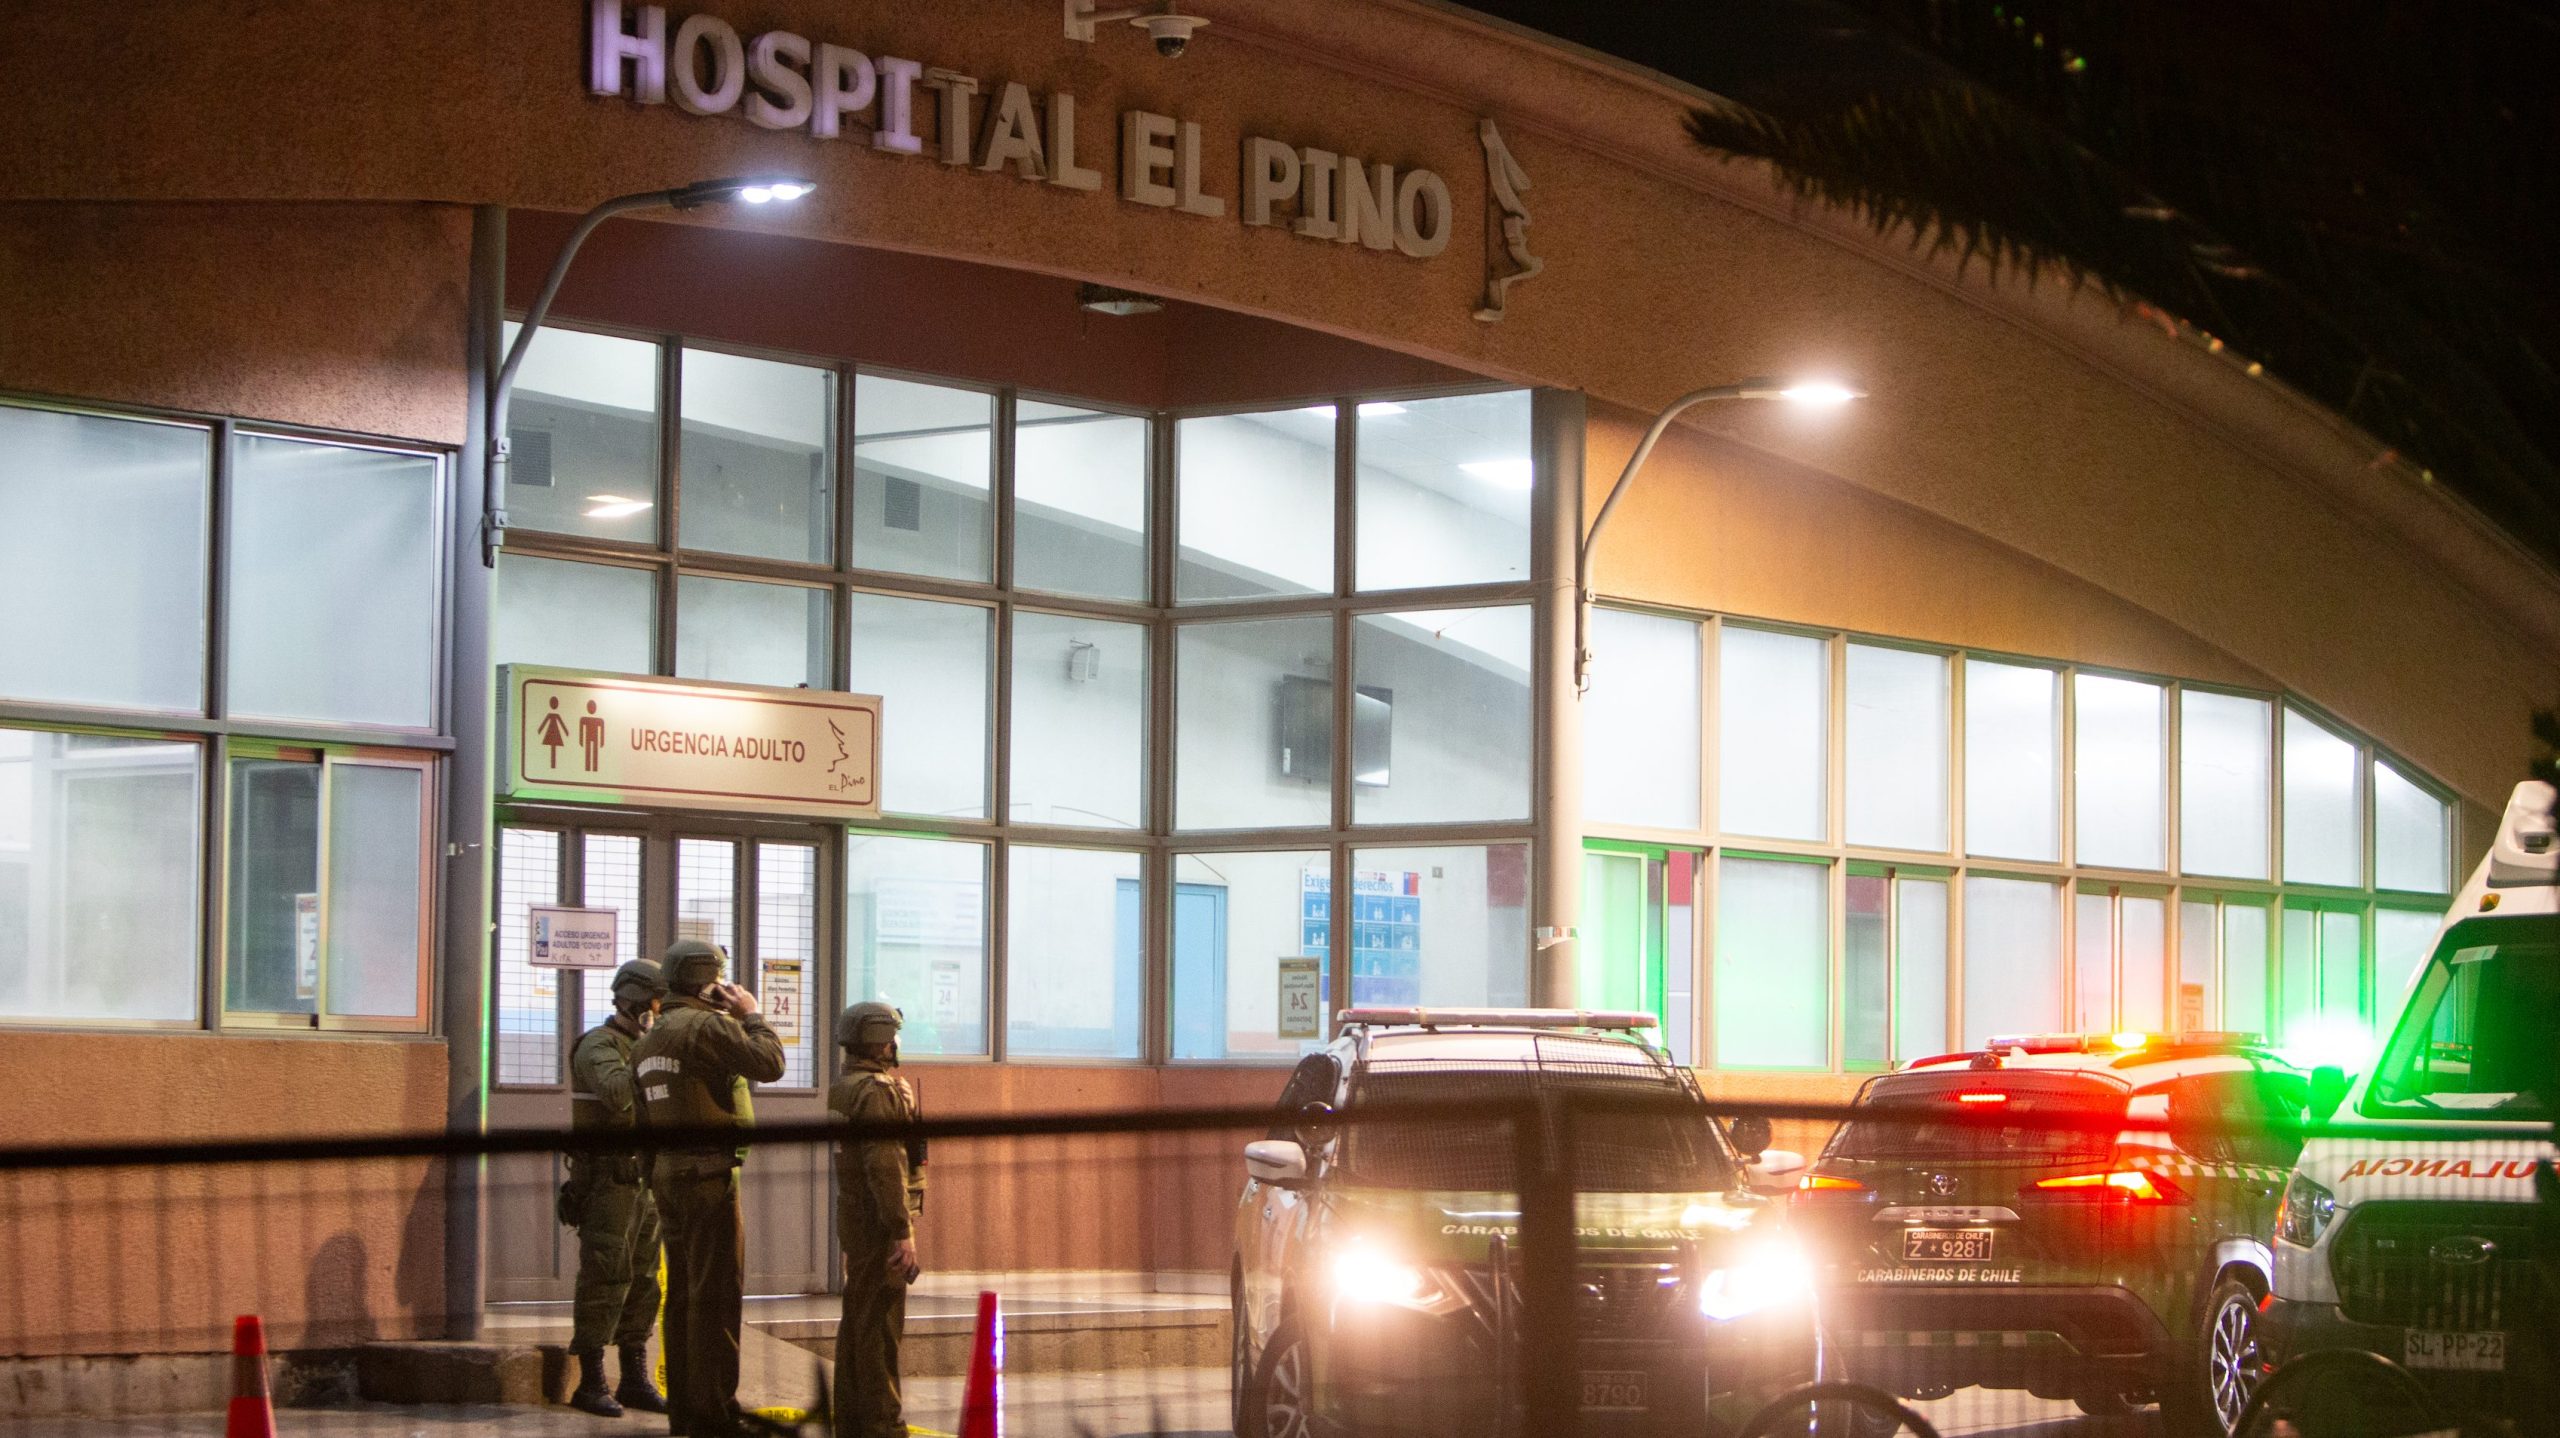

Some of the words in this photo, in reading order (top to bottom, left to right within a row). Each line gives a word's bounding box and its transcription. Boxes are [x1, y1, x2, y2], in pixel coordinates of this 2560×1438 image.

[590, 0, 1101, 191] HOSPITAL
[1122, 109, 1225, 218] EL
[1243, 136, 1453, 258] PINO
[631, 728, 728, 756] URGENCIA
[733, 736, 806, 763] ADULTO
[841, 773, 866, 793] Pino
[555, 930, 580, 939] ACCESO
[581, 931, 610, 940] URGENCIA
[553, 941, 580, 950] ADULTOS
[774, 996, 789, 1015] 24
[1606, 1226, 1636, 1239] DE
[1640, 1227, 1705, 1241] CHILE
[1911, 1231, 1955, 1240] CARABINEROS
[1956, 1232, 1964, 1240] DE
[1965, 1232, 1984, 1240] CHILE
[1942, 1240, 1984, 1258] 9281
[1858, 1268, 1954, 1283] CARABINEROS
[1958, 1269, 1977, 1283] DE
[1981, 1269, 2021, 1284] CHILE
